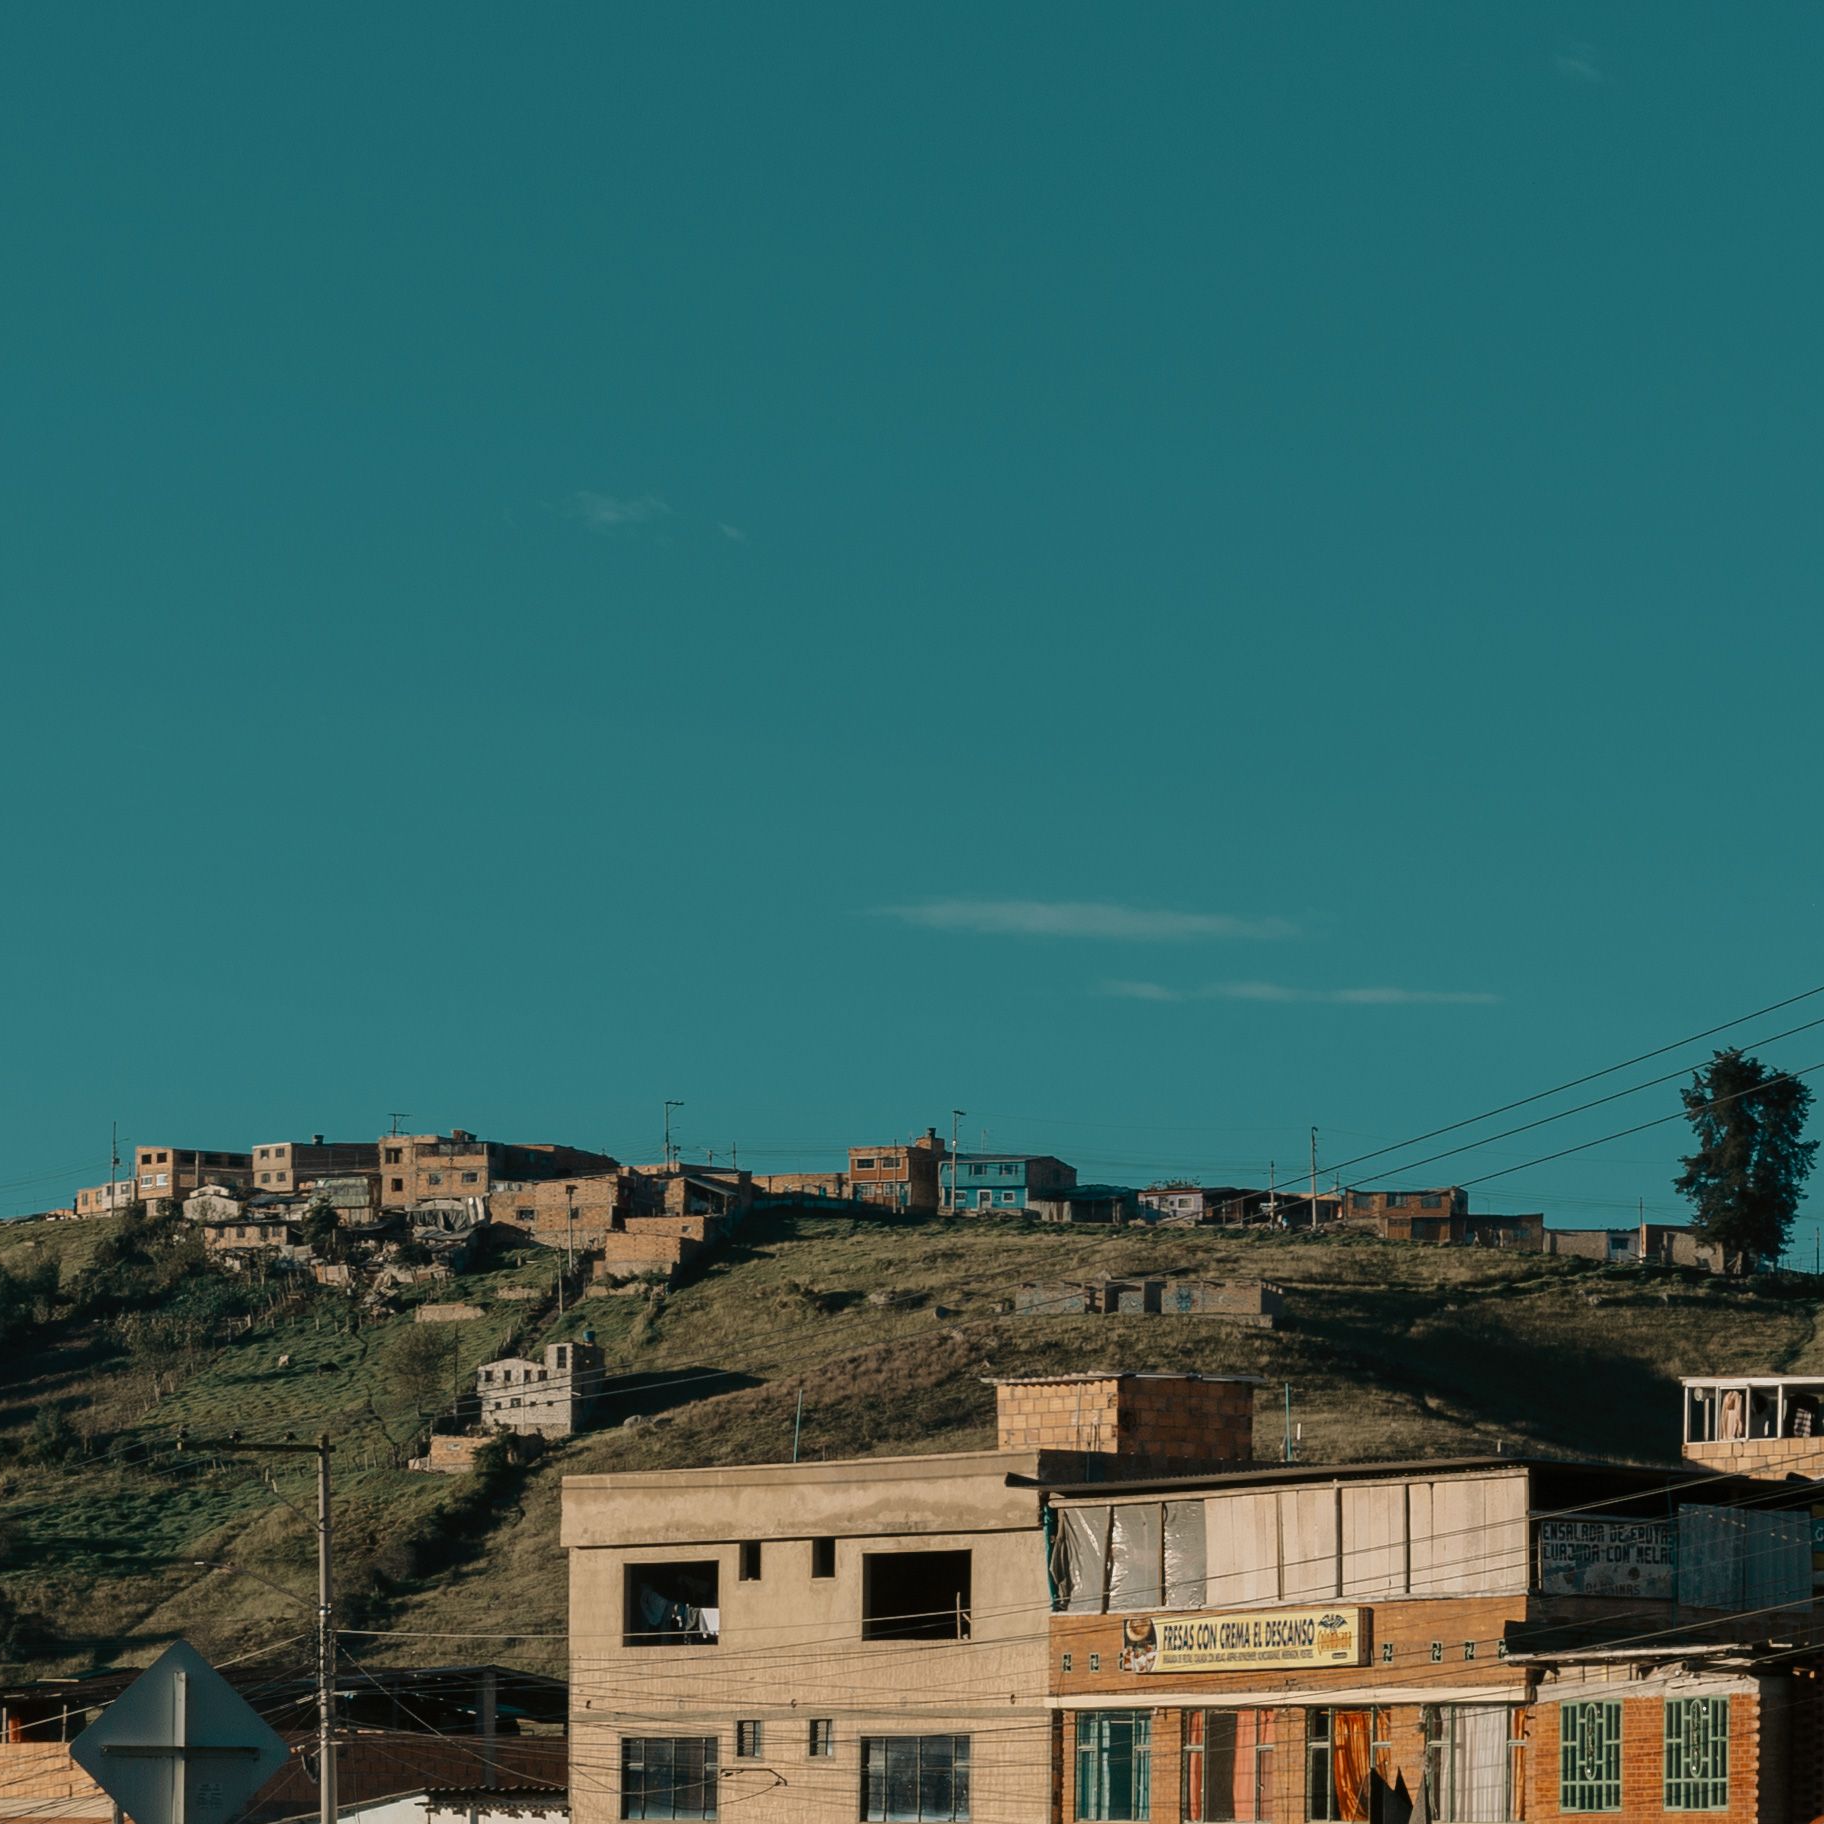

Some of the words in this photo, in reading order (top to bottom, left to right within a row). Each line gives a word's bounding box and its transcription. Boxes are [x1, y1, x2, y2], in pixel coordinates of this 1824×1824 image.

[1543, 1521, 1605, 1543] ENSALADA
[1610, 1525, 1625, 1543] DE
[1606, 1546, 1631, 1565] CON
[1164, 1624, 1194, 1651] FRESAS
[1197, 1623, 1217, 1650] CON
[1220, 1622, 1251, 1649] CREMA
[1254, 1621, 1262, 1648] EL
[1265, 1618, 1315, 1647] DESCANSO
